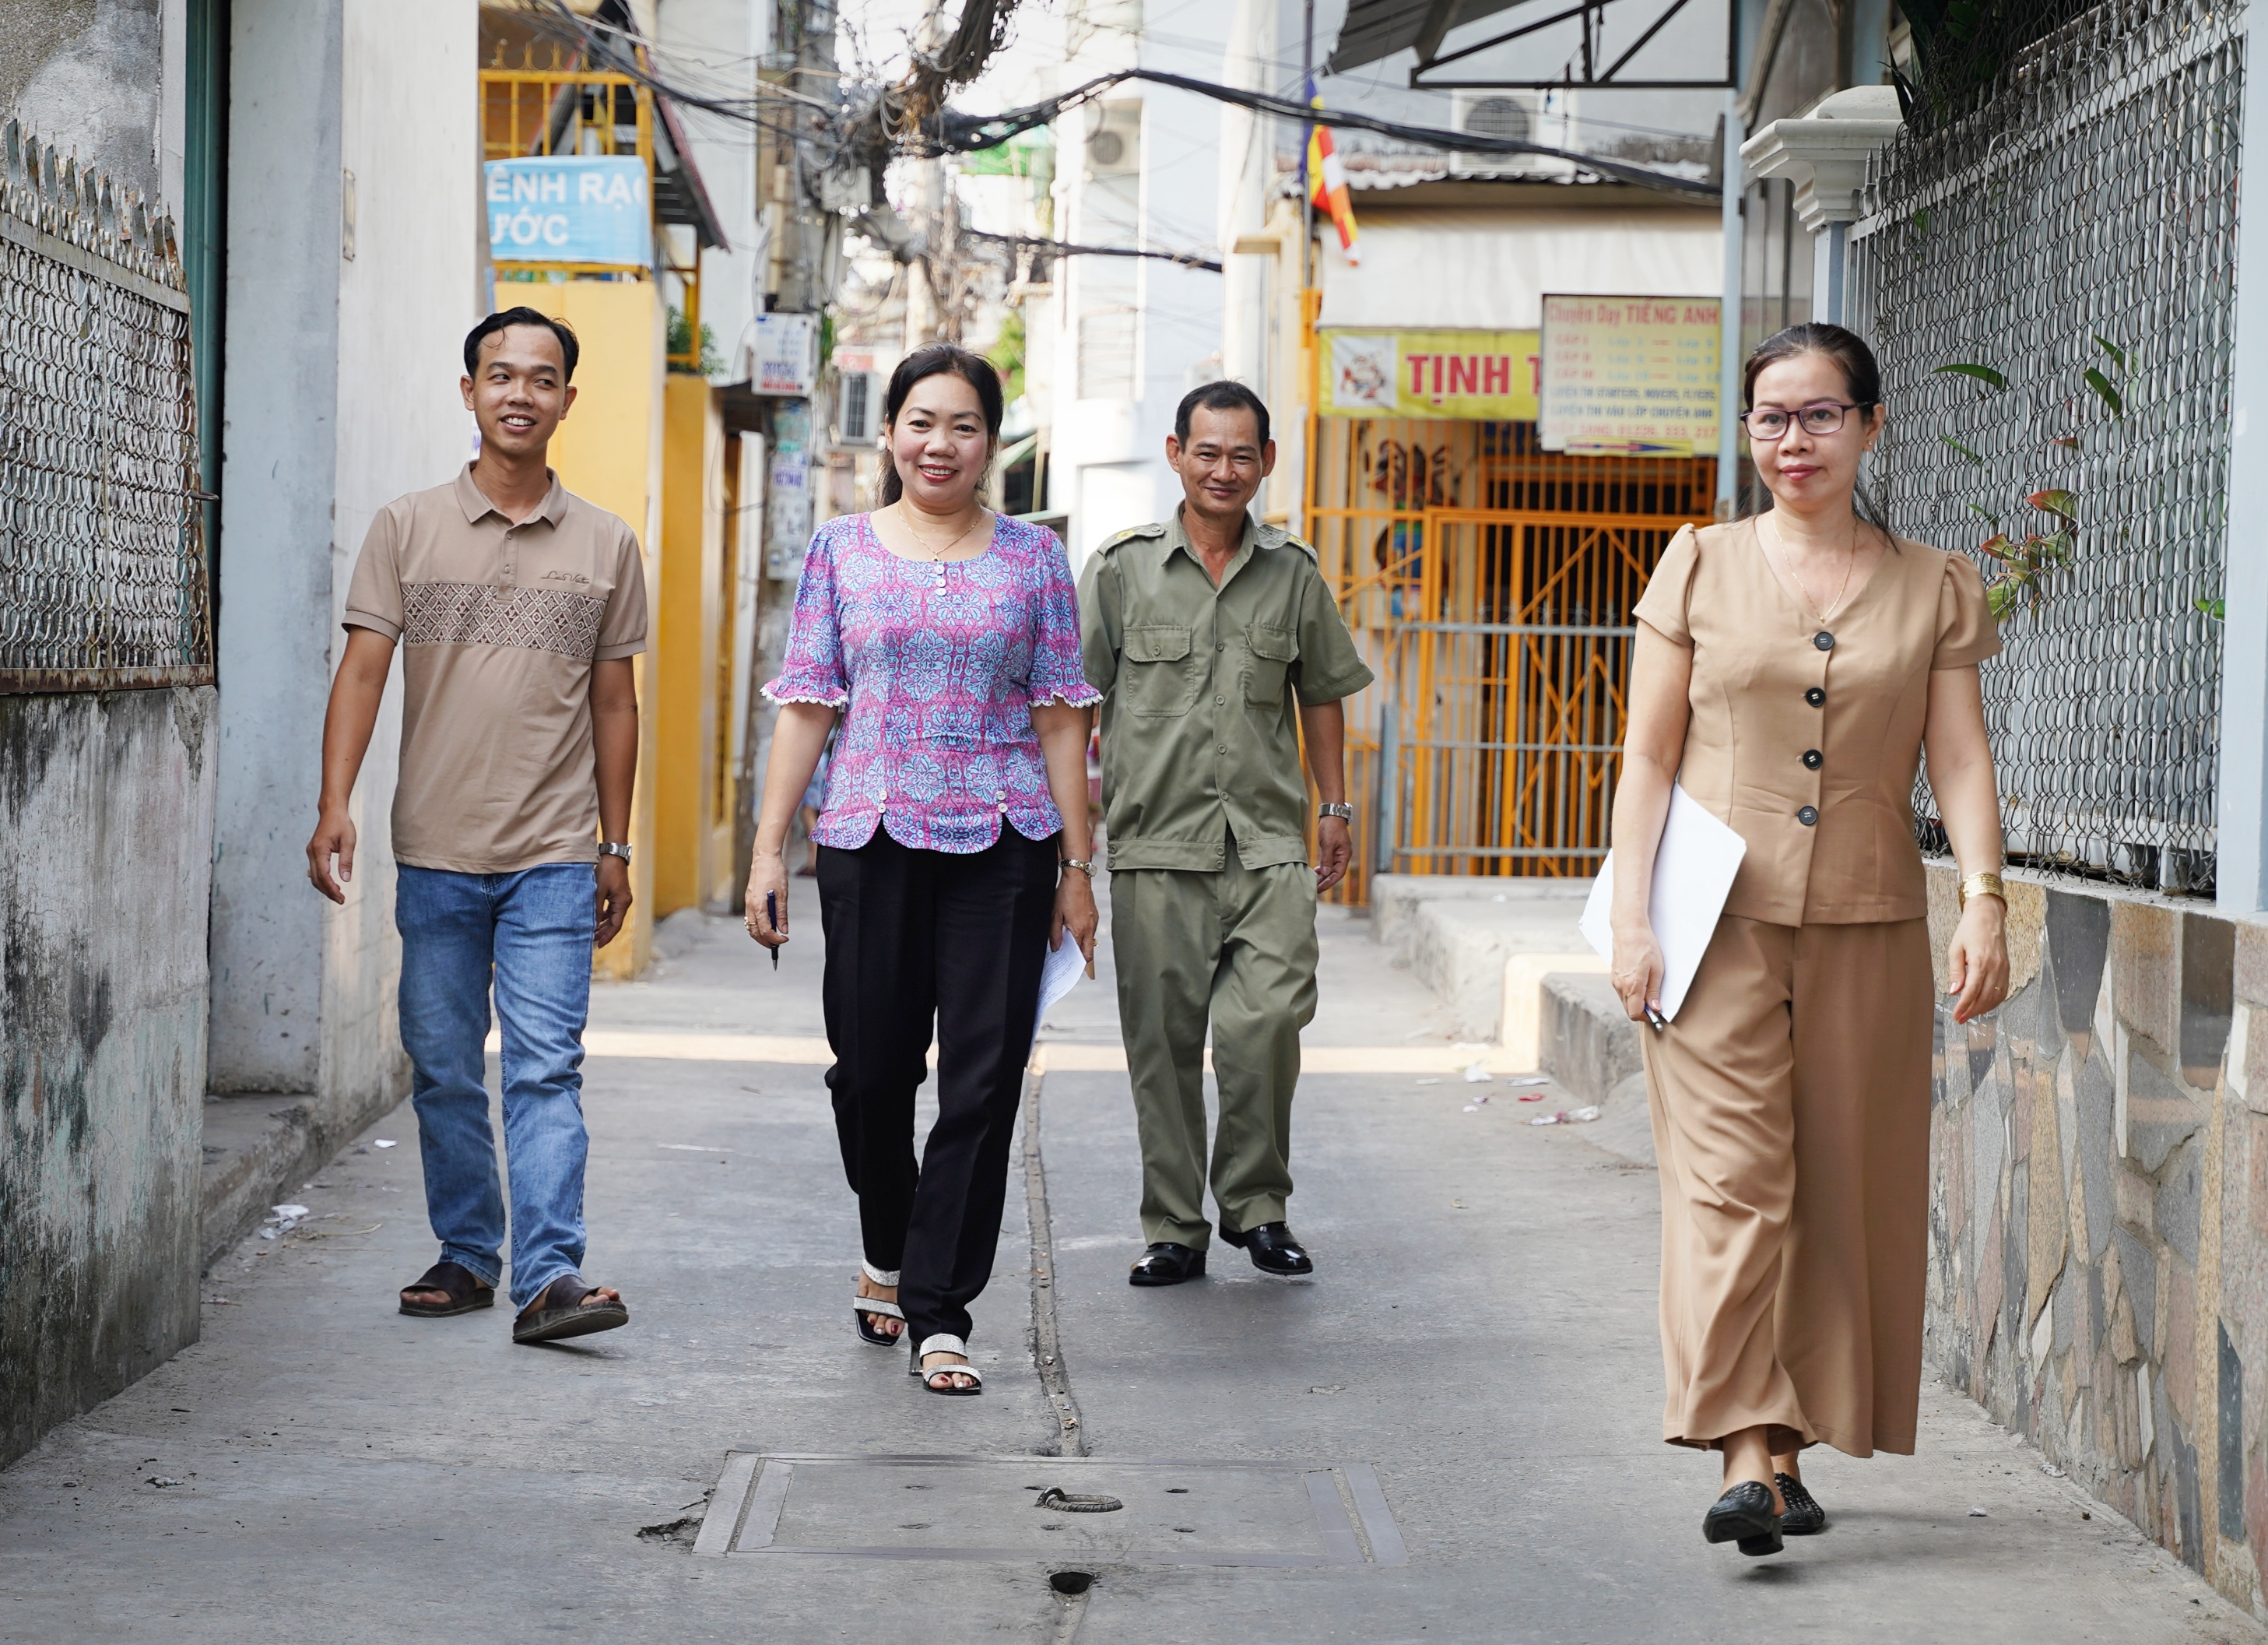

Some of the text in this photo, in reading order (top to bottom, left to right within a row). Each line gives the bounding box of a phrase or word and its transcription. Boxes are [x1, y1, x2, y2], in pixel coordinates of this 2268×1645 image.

[1625, 299, 1676, 325] TIẾNG
[1682, 306, 1719, 325] ANH
[1406, 355, 1510, 405] TỊNH
